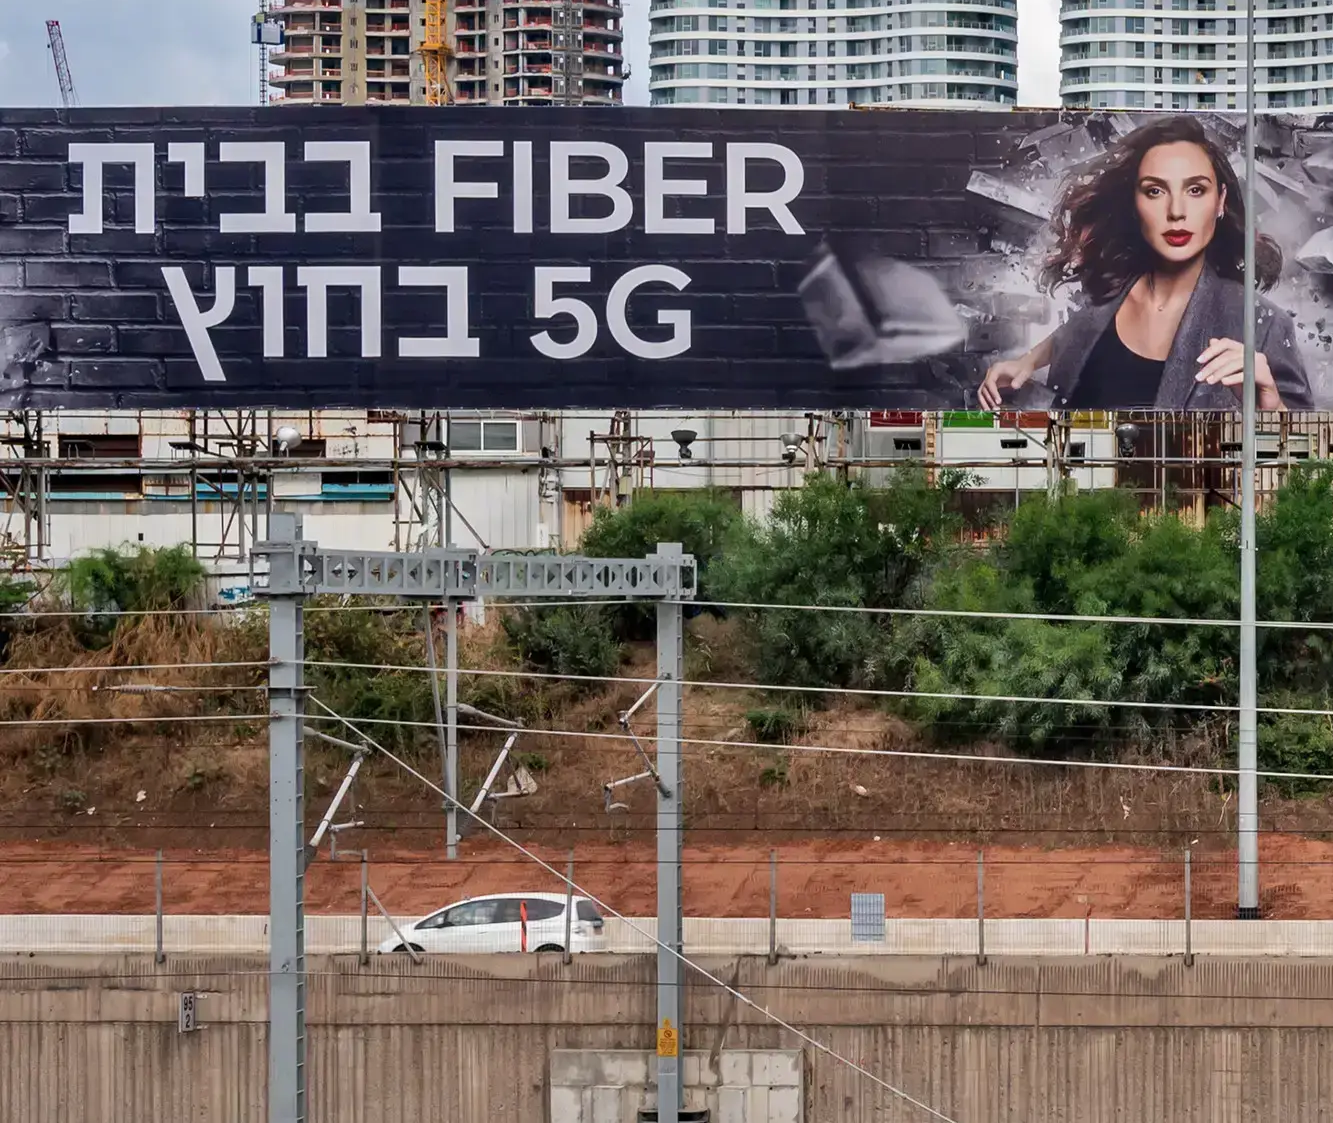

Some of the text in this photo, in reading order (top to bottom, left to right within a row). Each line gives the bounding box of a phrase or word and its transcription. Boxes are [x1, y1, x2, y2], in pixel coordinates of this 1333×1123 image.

[68, 140, 805, 235] FIBER בבית
[161, 264, 693, 381] 5G בחוץ
[183, 996, 193, 1011] 95
[185, 1013, 191, 1028] 2
